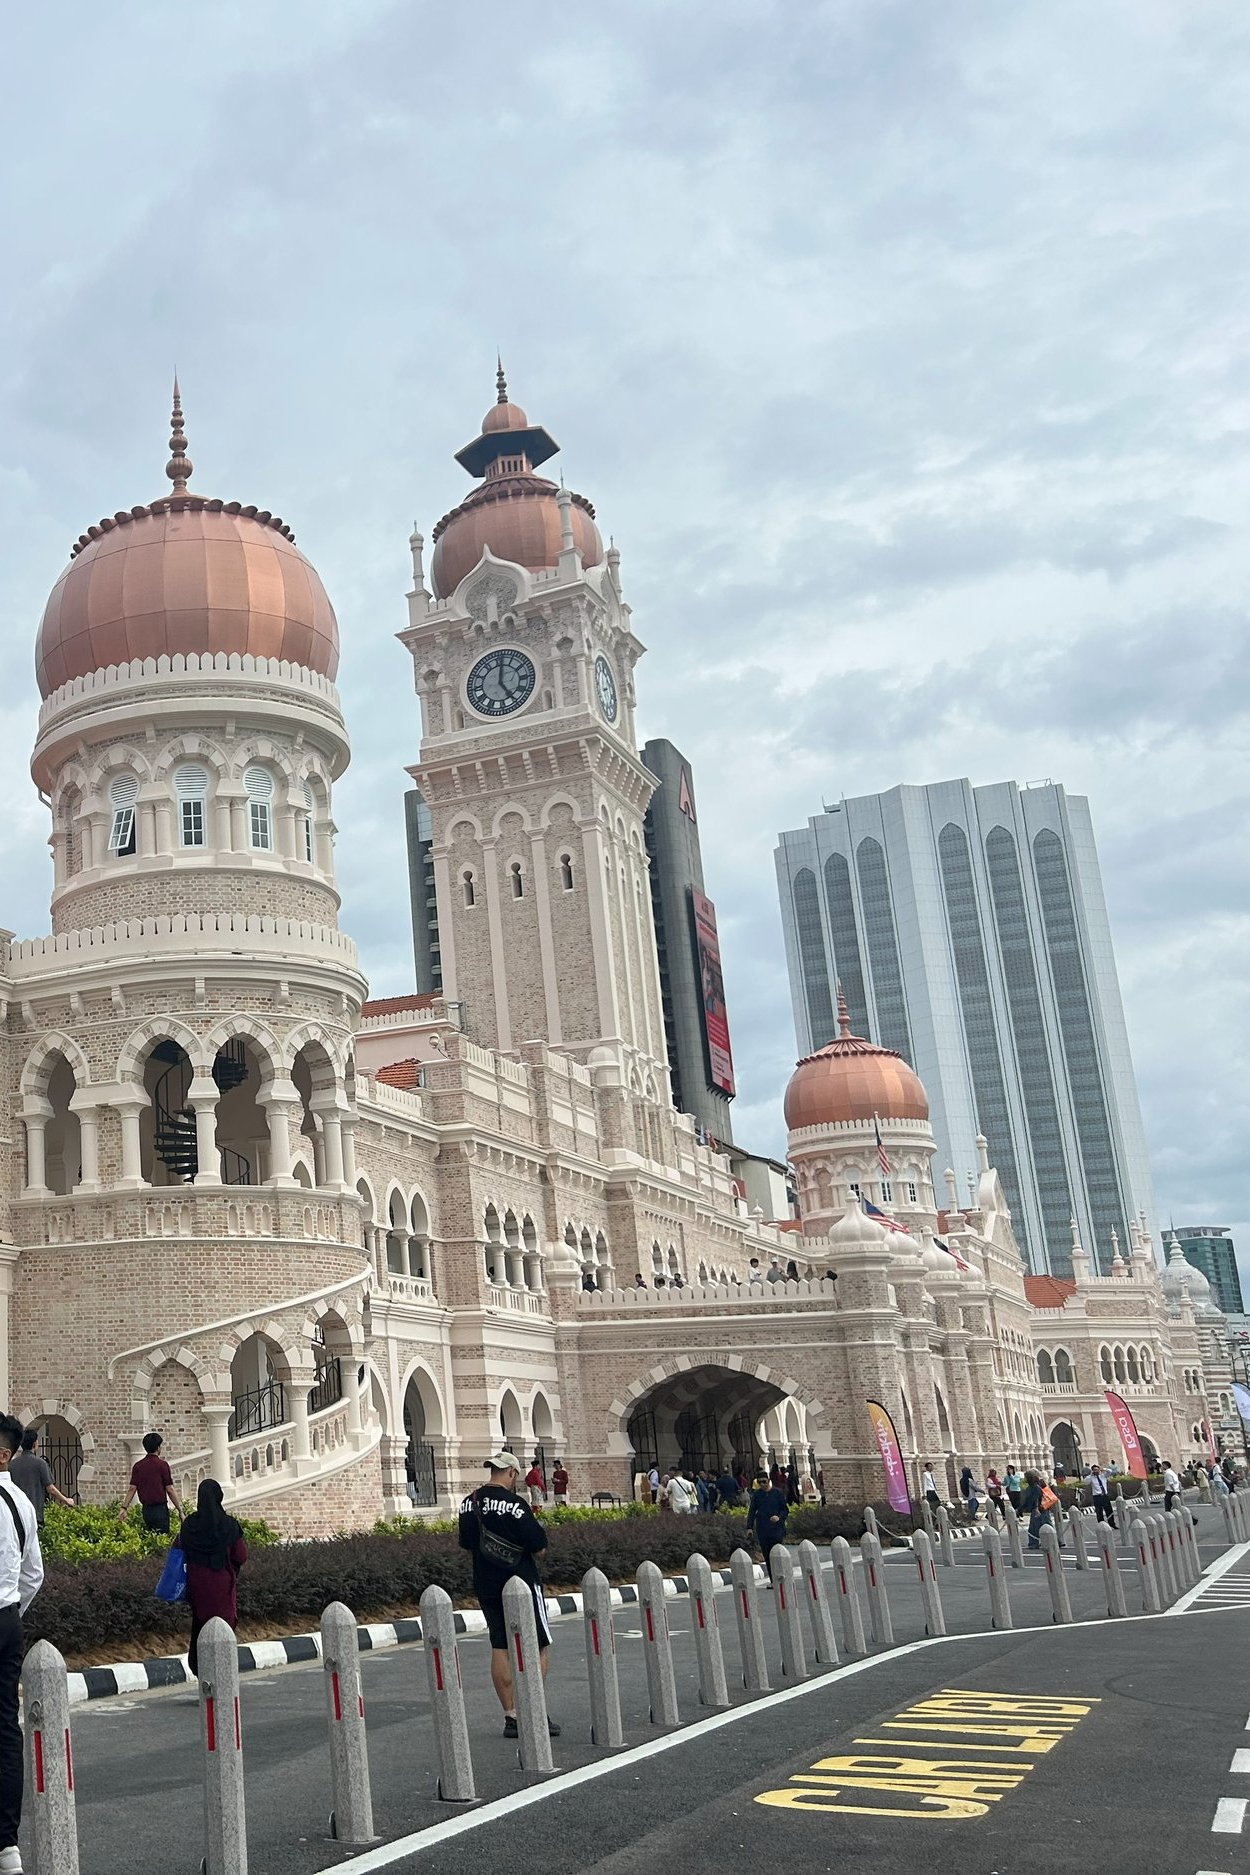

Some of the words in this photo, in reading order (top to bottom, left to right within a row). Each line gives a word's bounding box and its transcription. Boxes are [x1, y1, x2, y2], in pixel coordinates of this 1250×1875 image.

[482, 1497, 525, 1519] Angels
[851, 1688, 1103, 1754] LAYBY
[753, 1755, 1035, 1819] CAR
